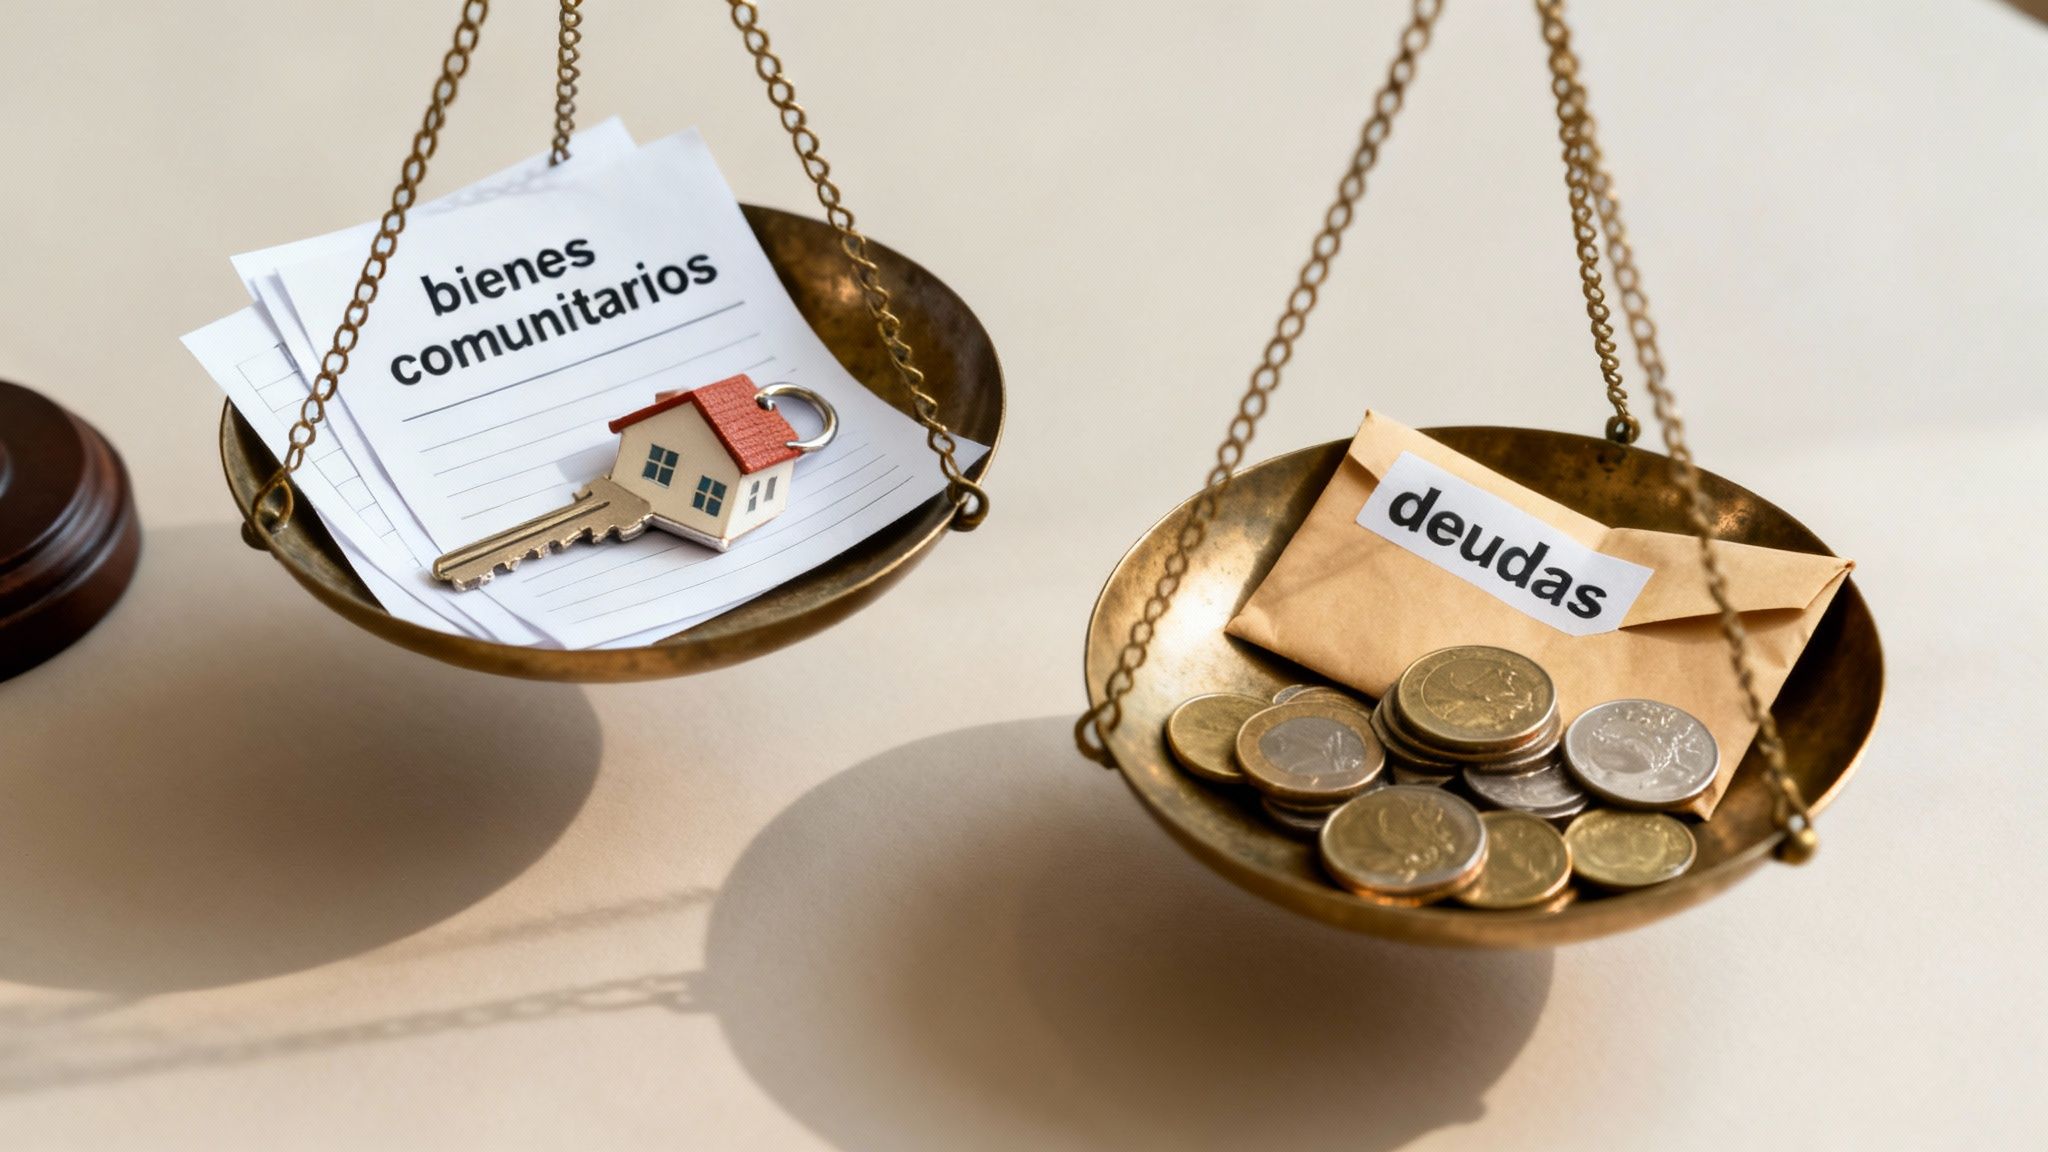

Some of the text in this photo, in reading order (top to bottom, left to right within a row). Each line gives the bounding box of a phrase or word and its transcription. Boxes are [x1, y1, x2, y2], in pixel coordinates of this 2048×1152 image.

[390, 254, 718, 386] comunitarios
[420, 238, 596, 316] bienes
[1388, 487, 1607, 619] deudas
